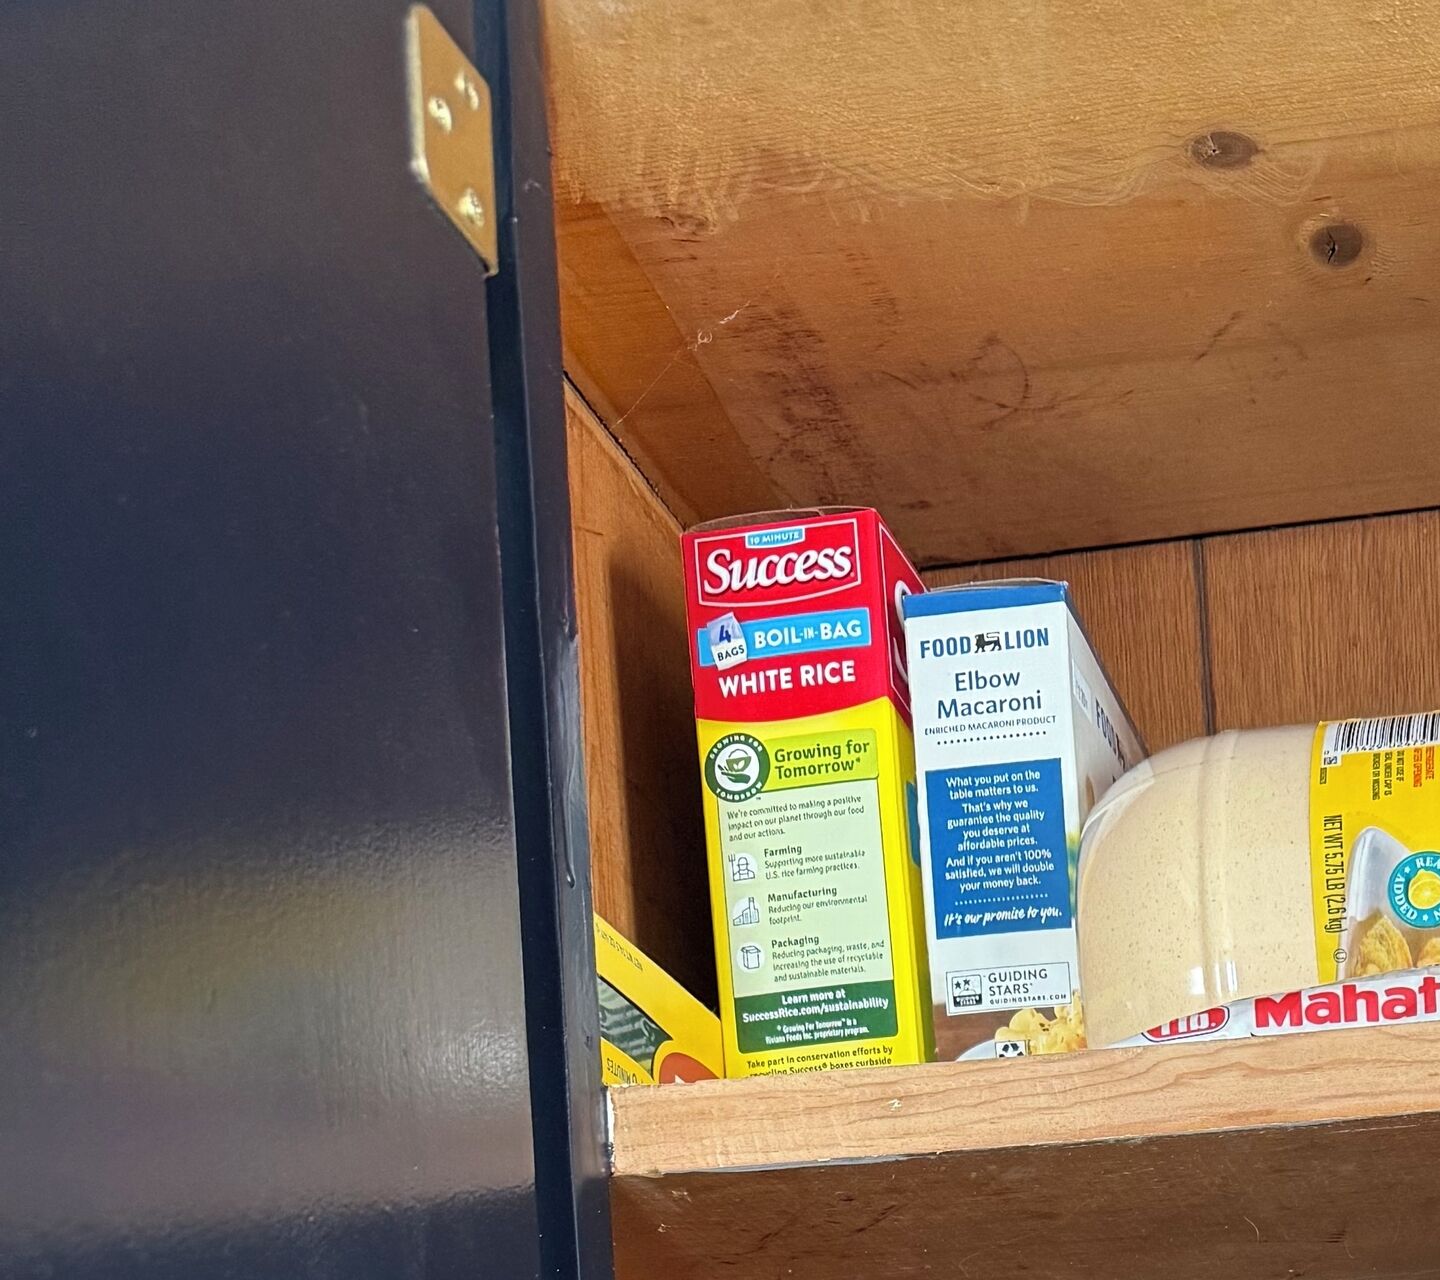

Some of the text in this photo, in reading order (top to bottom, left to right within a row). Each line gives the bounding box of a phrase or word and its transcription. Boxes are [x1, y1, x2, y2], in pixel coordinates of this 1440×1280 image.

[750, 531, 800, 545] 10 MINUTE
[704, 546, 852, 594] Success
[718, 625, 731, 643] 4
[754, 620, 862, 649] BOIL-IN-BAG
[920, 628, 1049, 659] FOOD LION
[717, 645, 745, 662] BAGS
[718, 660, 856, 698] WHITE RICE
[955, 670, 1020, 691] Elbow
[938, 690, 1041, 719] Macaroni
[925, 715, 1056, 735] ENRICHED MACARONI PRODUCT
[775, 740, 870, 763] Growing for
[946, 777, 972, 788] What
[975, 777, 992, 786] you
[994, 774, 1008, 786] put
[1025, 770, 1041, 780] the
[764, 845, 802, 857] Farming
[1324, 815, 1348, 933] NET WT 5.75 LB (2.6 kg)
[768, 887, 837, 902] Manufacturing
[1393, 875, 1418, 921] ADDED
[771, 936, 819, 948] Packaging
[988, 969, 1048, 983] GUIDING
[781, 989, 845, 1005] Learn more at
[989, 984, 1030, 997] STARS
[742, 998, 889, 1023] SuccessRice.com/sustainability
